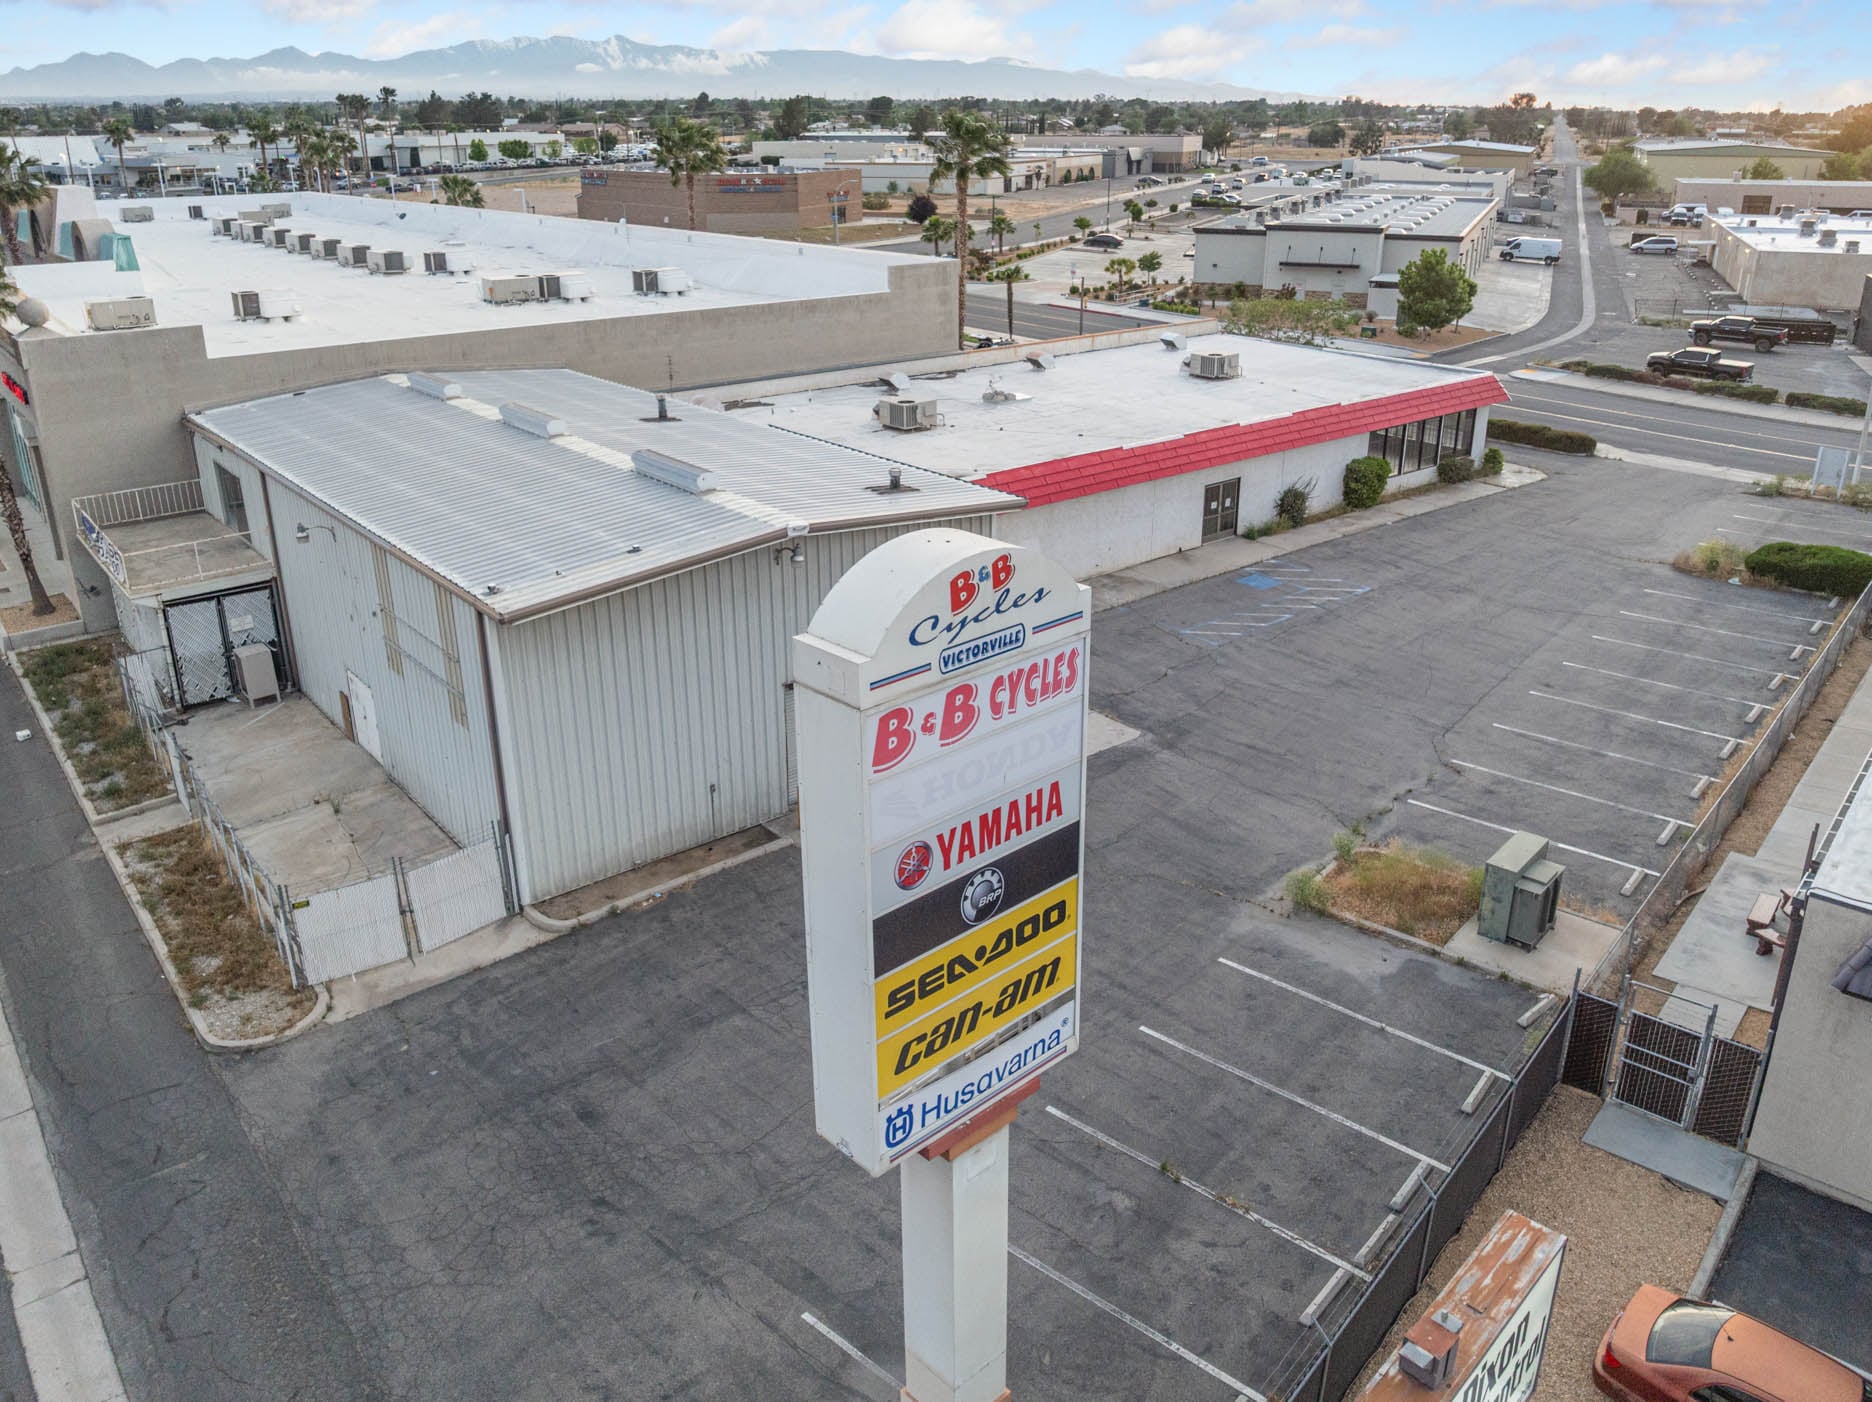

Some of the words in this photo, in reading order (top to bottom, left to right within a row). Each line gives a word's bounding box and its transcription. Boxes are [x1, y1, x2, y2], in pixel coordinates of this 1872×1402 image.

[908, 587, 1052, 646] Cycles
[942, 629, 1022, 669] VICTORVILLE
[989, 647, 1079, 721] CYCLES
[936, 780, 1063, 872] YAMAHA
[979, 889, 1002, 907] BRP
[1487, 1314, 1547, 1402] ntrol
